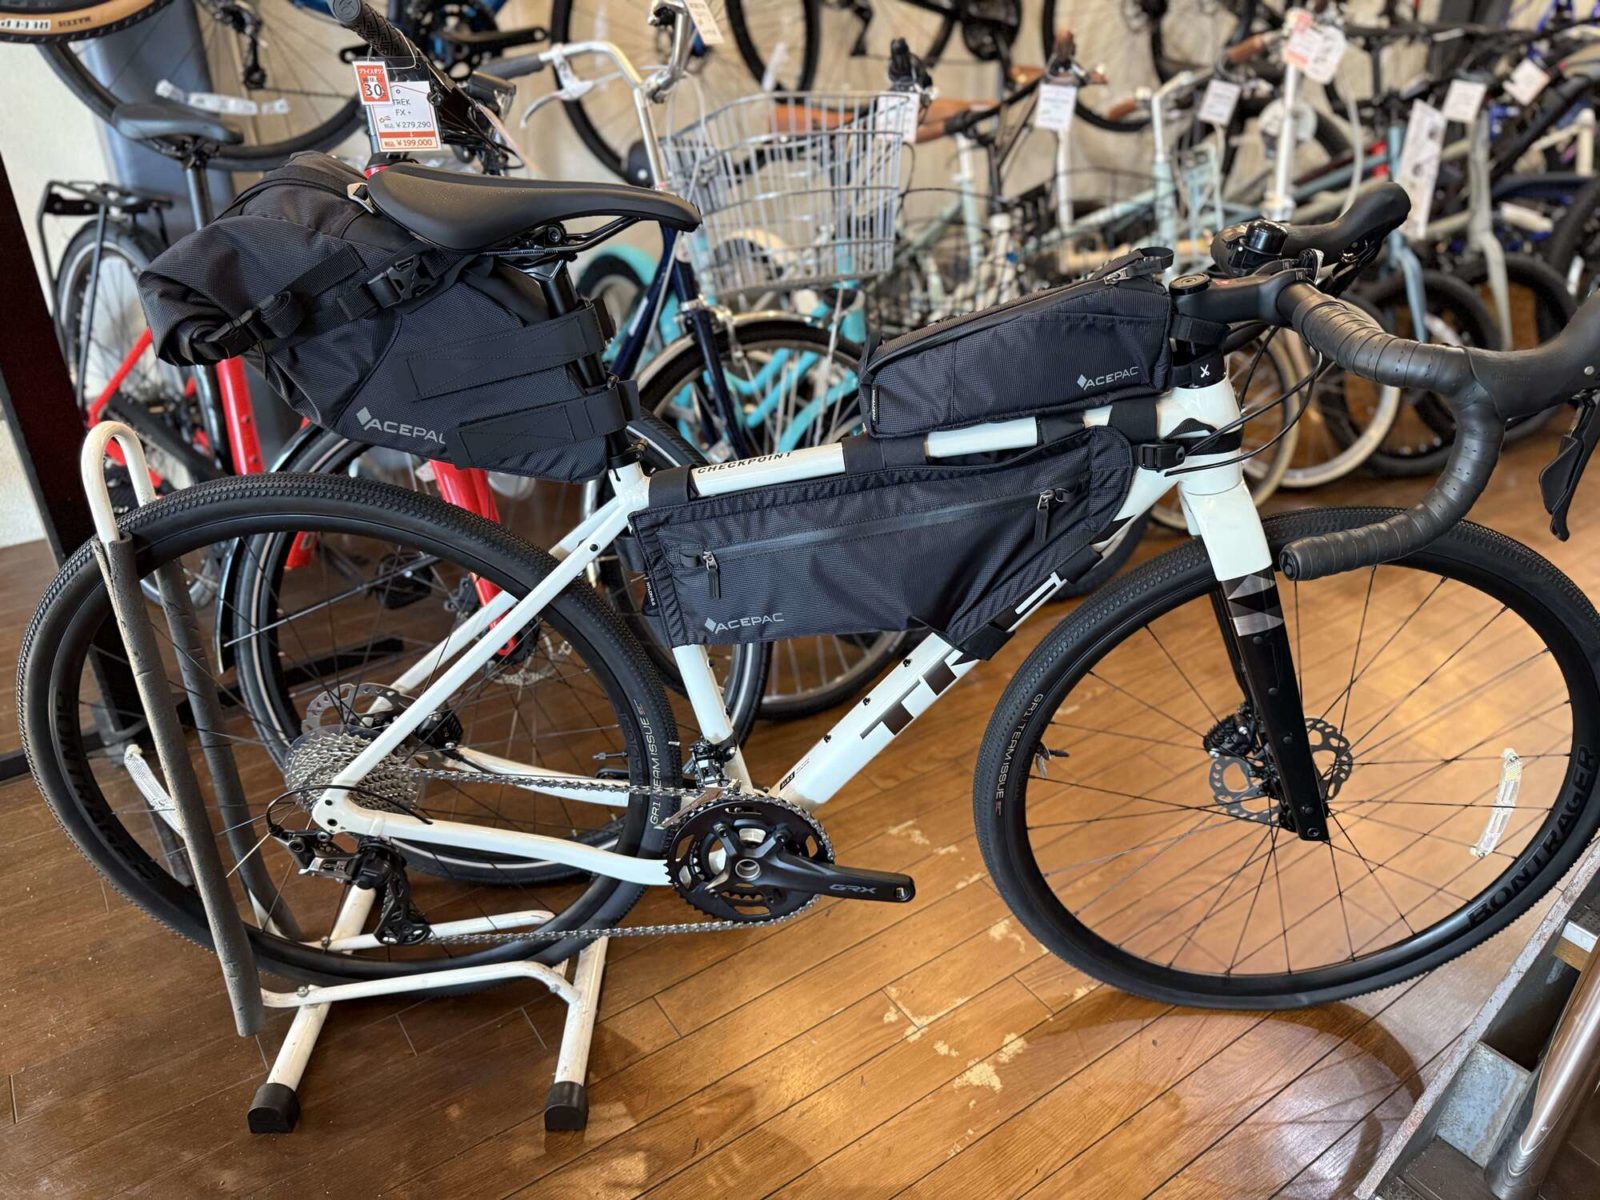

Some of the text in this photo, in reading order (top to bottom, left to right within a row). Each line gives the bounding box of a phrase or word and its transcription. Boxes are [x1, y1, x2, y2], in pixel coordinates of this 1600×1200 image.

[364, 83, 383, 97] 30
[1083, 366, 1139, 391] ACEPAC
[697, 451, 792, 474] CHECKPOINT
[714, 612, 785, 635] ACEPAC
[640, 716, 659, 756] ISSUE
[1004, 723, 1026, 761] TEAM
[995, 761, 1010, 799] ISSUE
[1467, 743, 1597, 928] BONTRAGER
[829, 883, 877, 894] GRX
